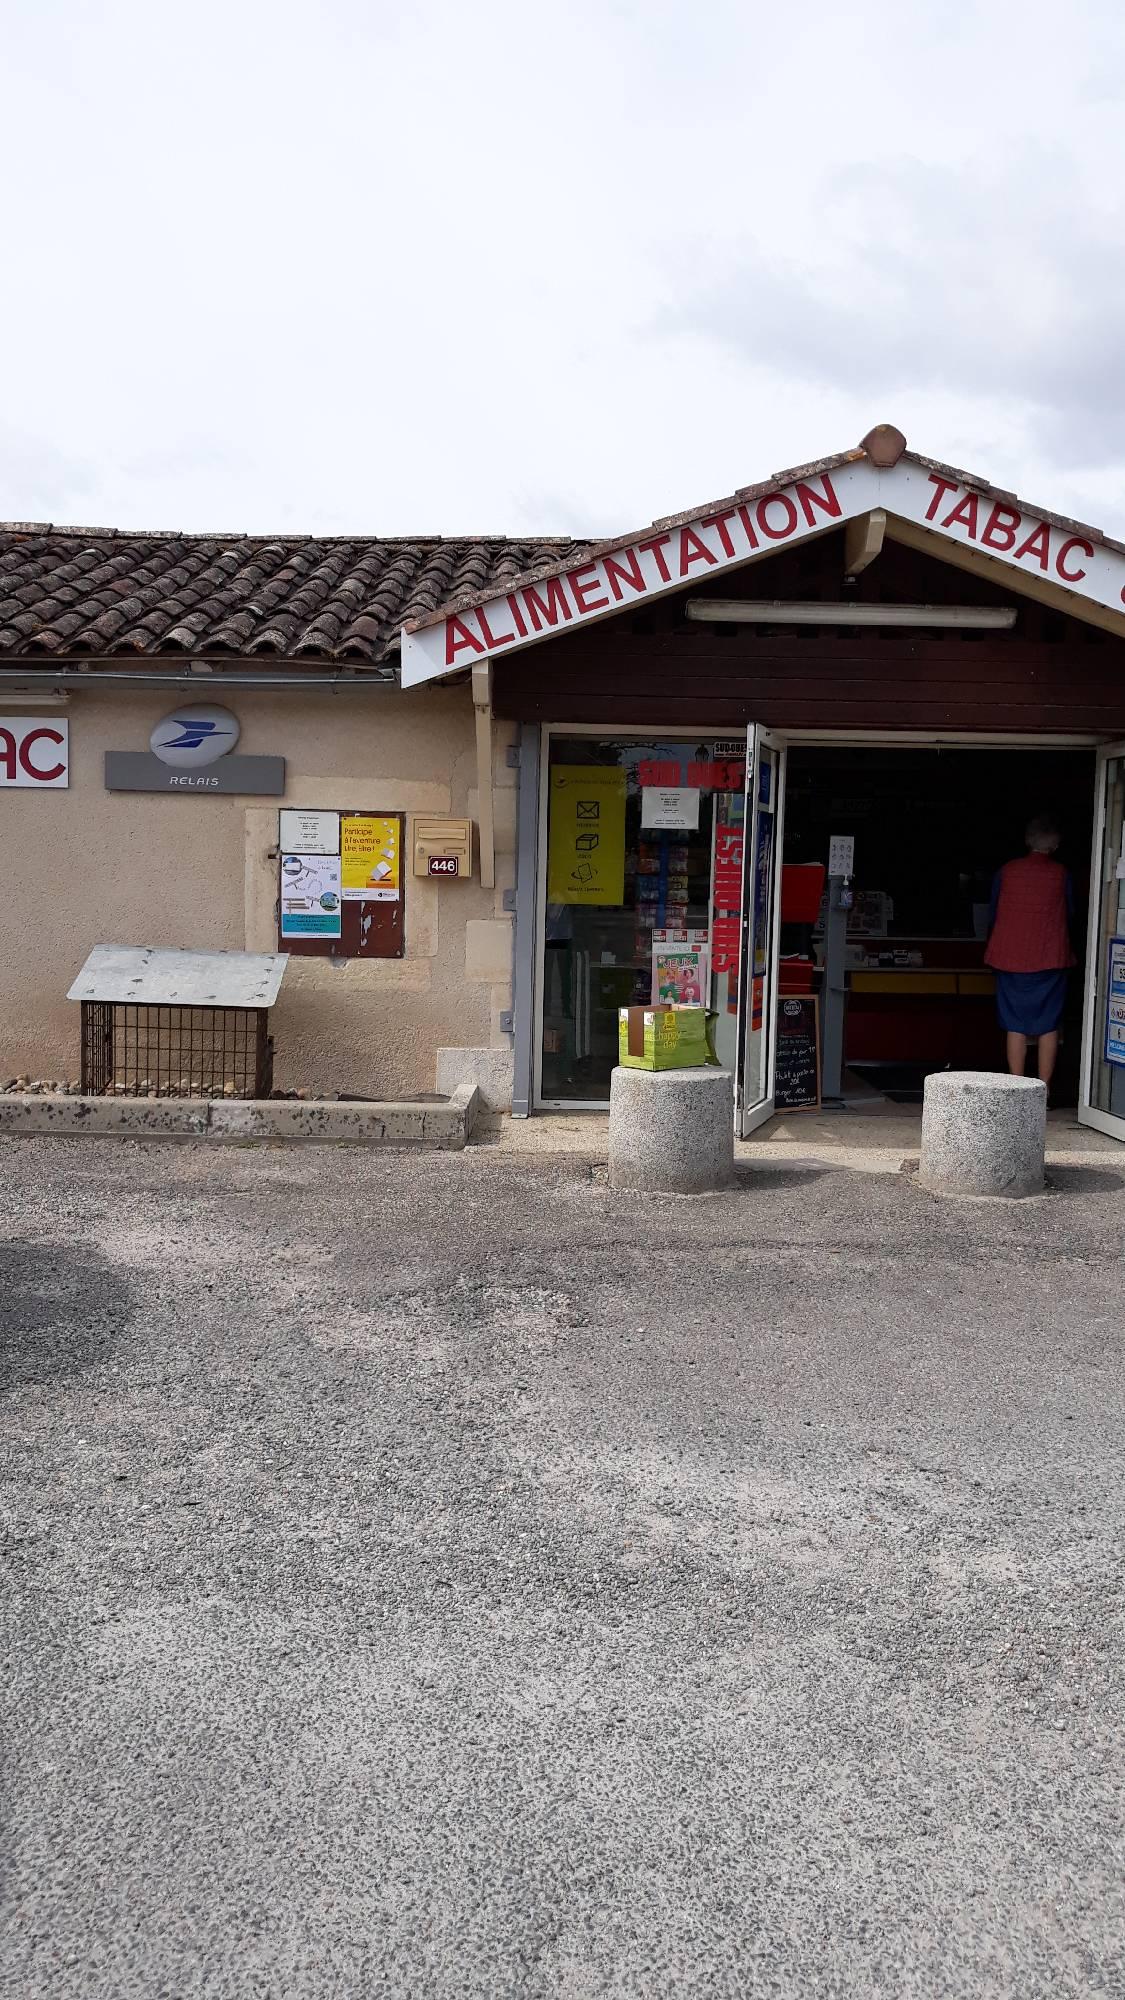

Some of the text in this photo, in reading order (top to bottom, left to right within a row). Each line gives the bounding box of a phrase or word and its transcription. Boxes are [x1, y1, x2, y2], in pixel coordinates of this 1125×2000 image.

[925, 473, 1095, 582] TABAC
[445, 474, 842, 665] ALIMENTATION
[169, 776, 219, 786] RELAIS
[345, 828, 373, 837] Participe
[431, 860, 456, 872] 446
[664, 958, 693, 968] JEUX
[659, 1031, 681, 1041] happy
[664, 1040, 678, 1049] day
